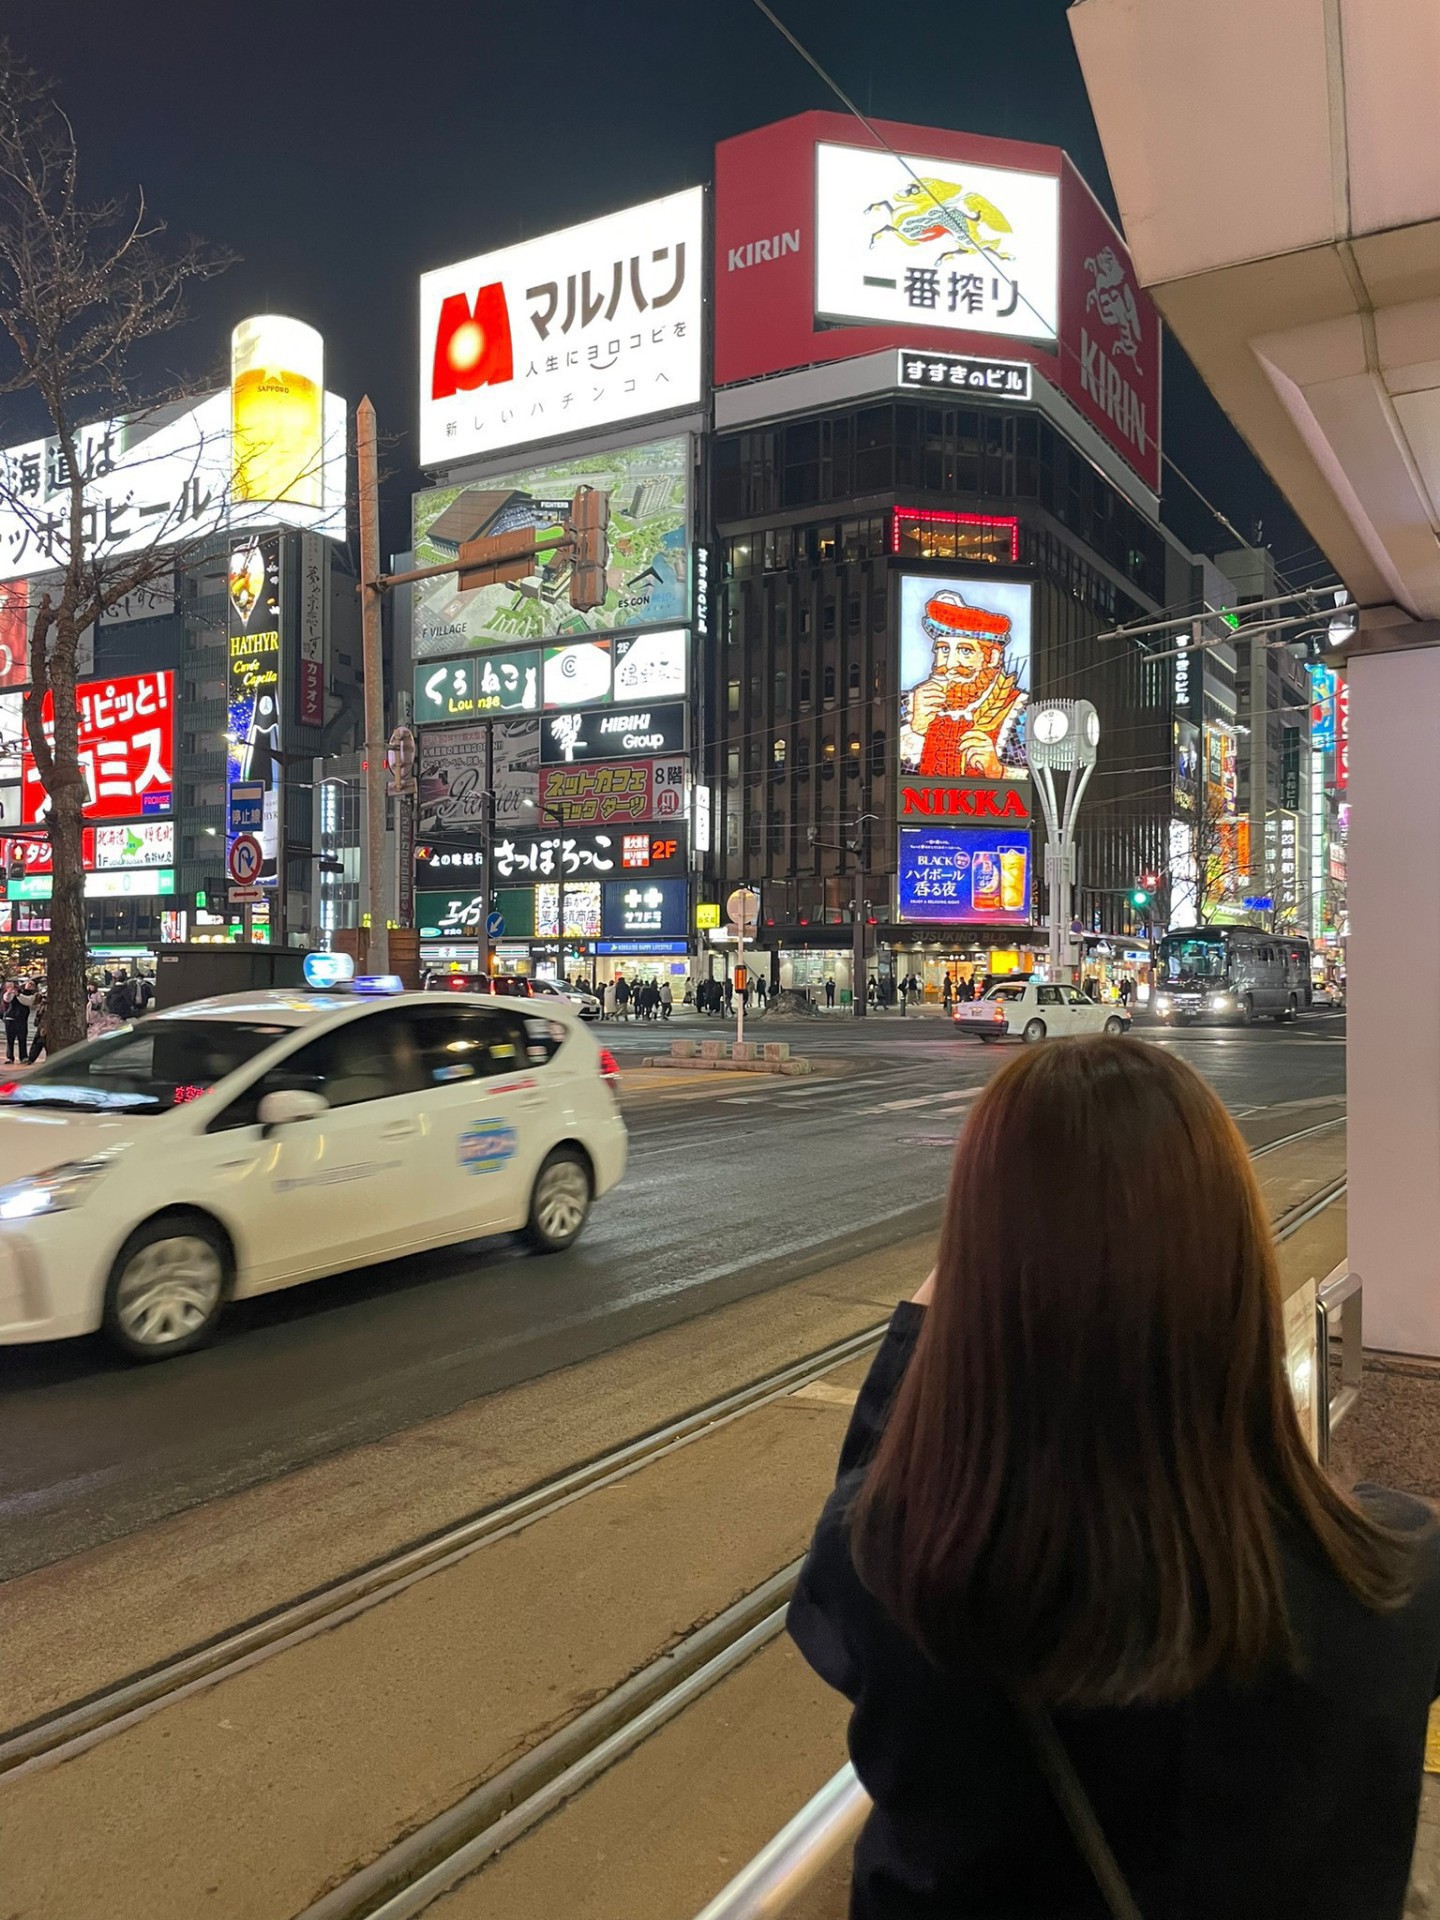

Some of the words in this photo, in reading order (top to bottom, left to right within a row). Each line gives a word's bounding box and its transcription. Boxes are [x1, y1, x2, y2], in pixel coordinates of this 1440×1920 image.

[728, 229, 800, 272] KIRIN
[526, 242, 686, 341] マルハン
[863, 266, 1019, 317] 一番搾り
[526, 321, 687, 378] 人生にヨロコビを
[907, 361, 1023, 391] すすきのビル
[257, 385, 290, 394] SAPPORO
[1080, 327, 1147, 457] KIRIN
[0, 437, 117, 499] 海道は
[0, 476, 212, 565] ッポロビール
[631, 596, 650, 606] CON
[422, 626, 428, 638] F
[430, 622, 467, 638] VILLAGE
[230, 631, 279, 656] HATHYR
[617, 641, 630, 654] 2F
[307, 663, 318, 713] カラオケ
[425, 661, 519, 705] くろねこ
[448, 695, 500, 713] Lounge
[600, 714, 651, 733] HIBIKI
[622, 733, 665, 750] Group
[545, 768, 647, 799] ネットカフェ
[654, 766, 683, 786] 8階
[544, 801, 598, 822] コミック
[601, 795, 647, 820] ダーツ
[901, 787, 1030, 817] NIKKA
[494, 835, 615, 877] さっぽろっこ
[651, 840, 678, 860] 2F
[917, 855, 953, 866] BLACK
[905, 868, 965, 881] ハイボール
[914, 881, 957, 897] 香る夜
[910, 931, 977, 942] SUSUKINO
